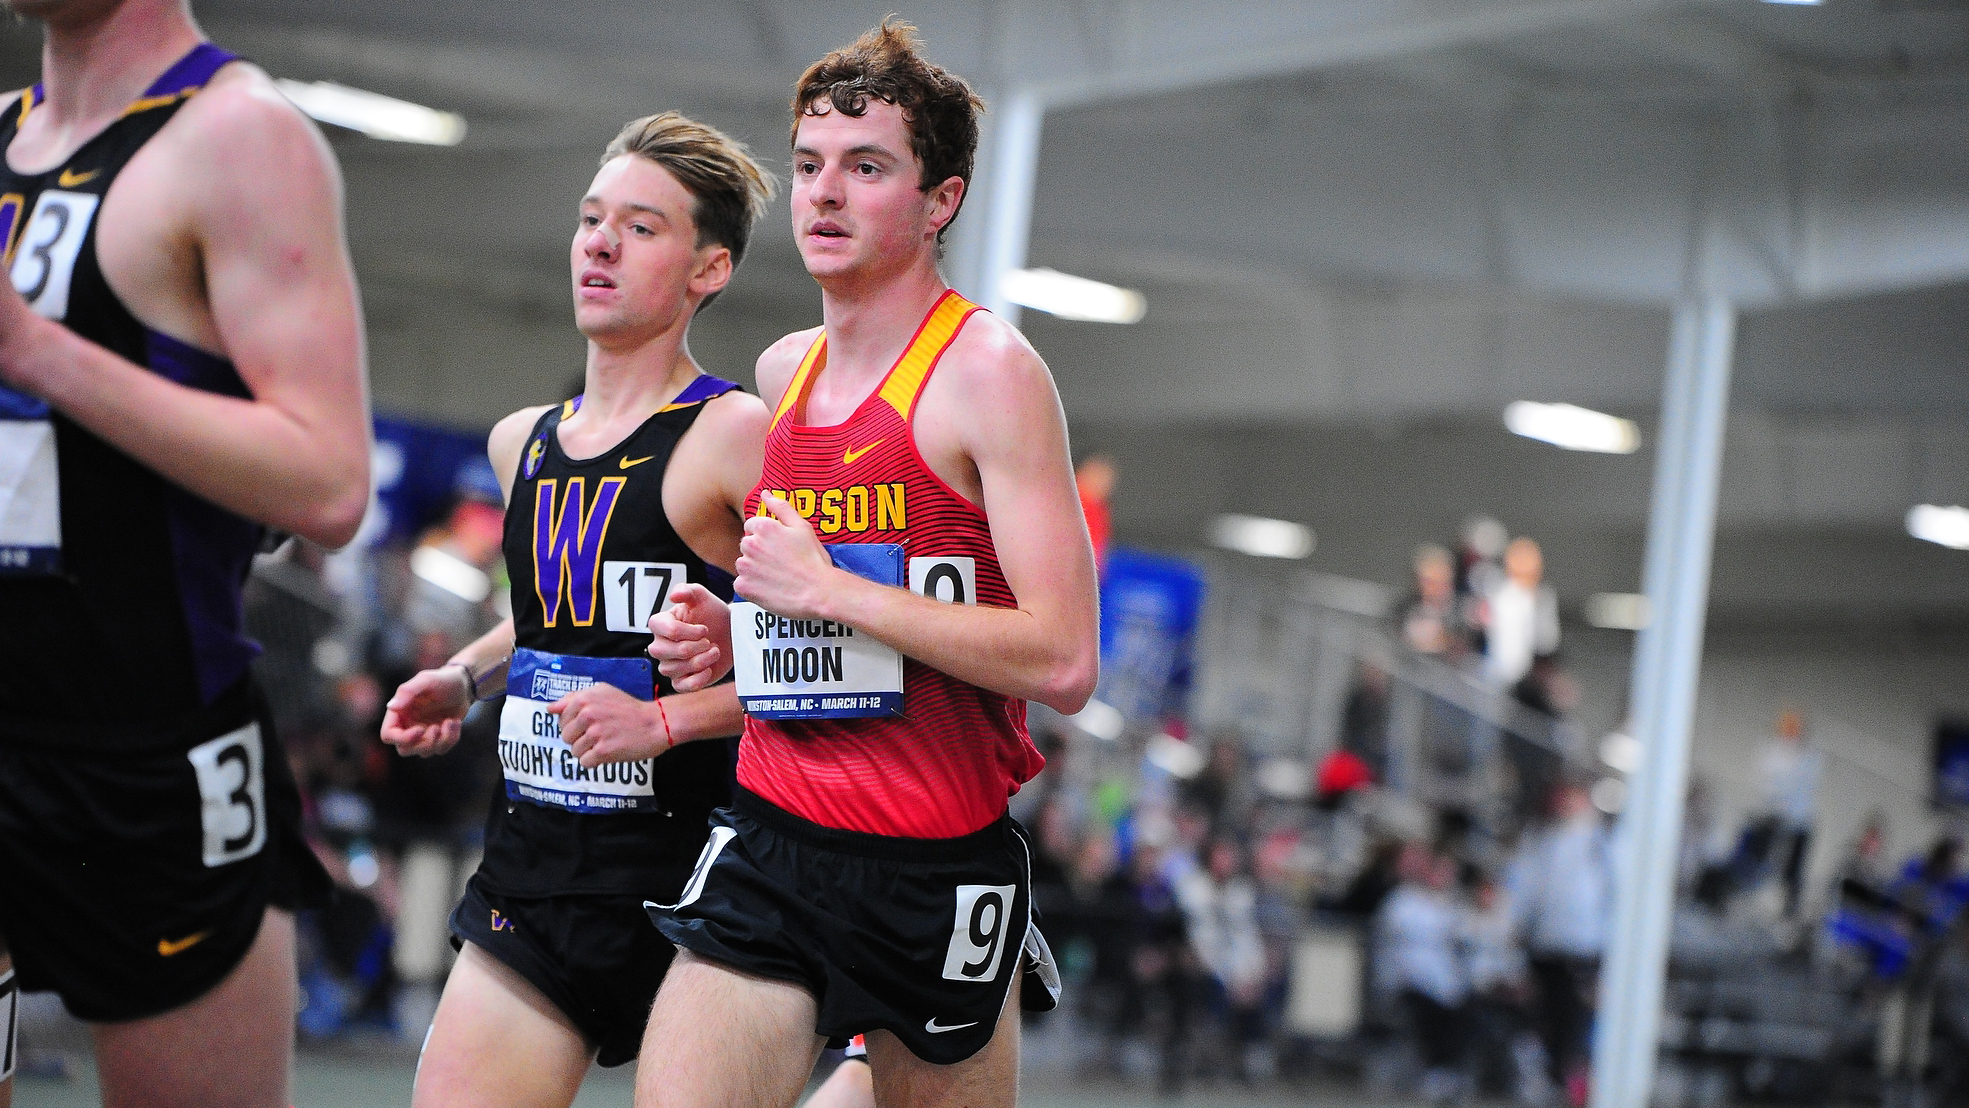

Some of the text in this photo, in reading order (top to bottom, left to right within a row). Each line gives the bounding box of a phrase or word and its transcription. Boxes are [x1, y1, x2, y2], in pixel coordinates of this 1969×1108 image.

[23, 203, 70, 303] 3
[533, 477, 628, 628] W
[618, 567, 672, 628] 17
[763, 646, 844, 684] MOON
[800, 698, 814, 710] NC
[821, 697, 857, 710] MARCH
[859, 696, 881, 709] 11-12
[500, 739, 553, 778] TUOHY
[217, 744, 256, 853] 3
[568, 794, 580, 806] NC
[587, 795, 616, 808] MARCH
[961, 891, 1004, 978] 9
